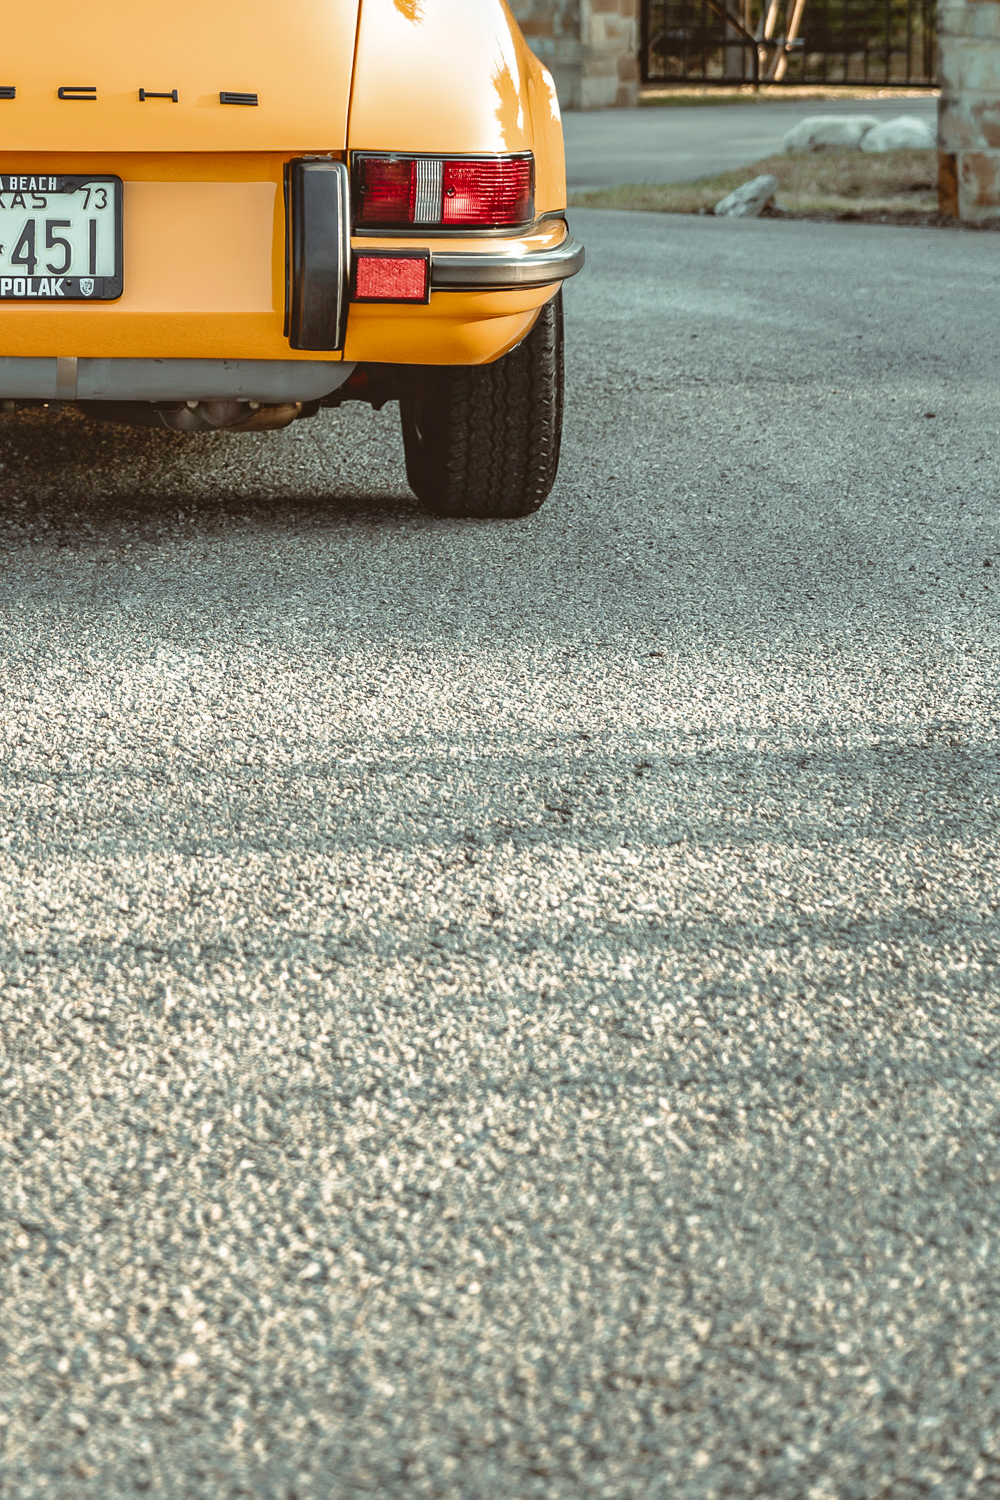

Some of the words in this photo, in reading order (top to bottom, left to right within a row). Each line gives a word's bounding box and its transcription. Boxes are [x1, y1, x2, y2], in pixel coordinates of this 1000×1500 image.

[9, 176, 57, 191] BEACH
[79, 187, 108, 209] 73
[0, 278, 65, 296] POLAK
